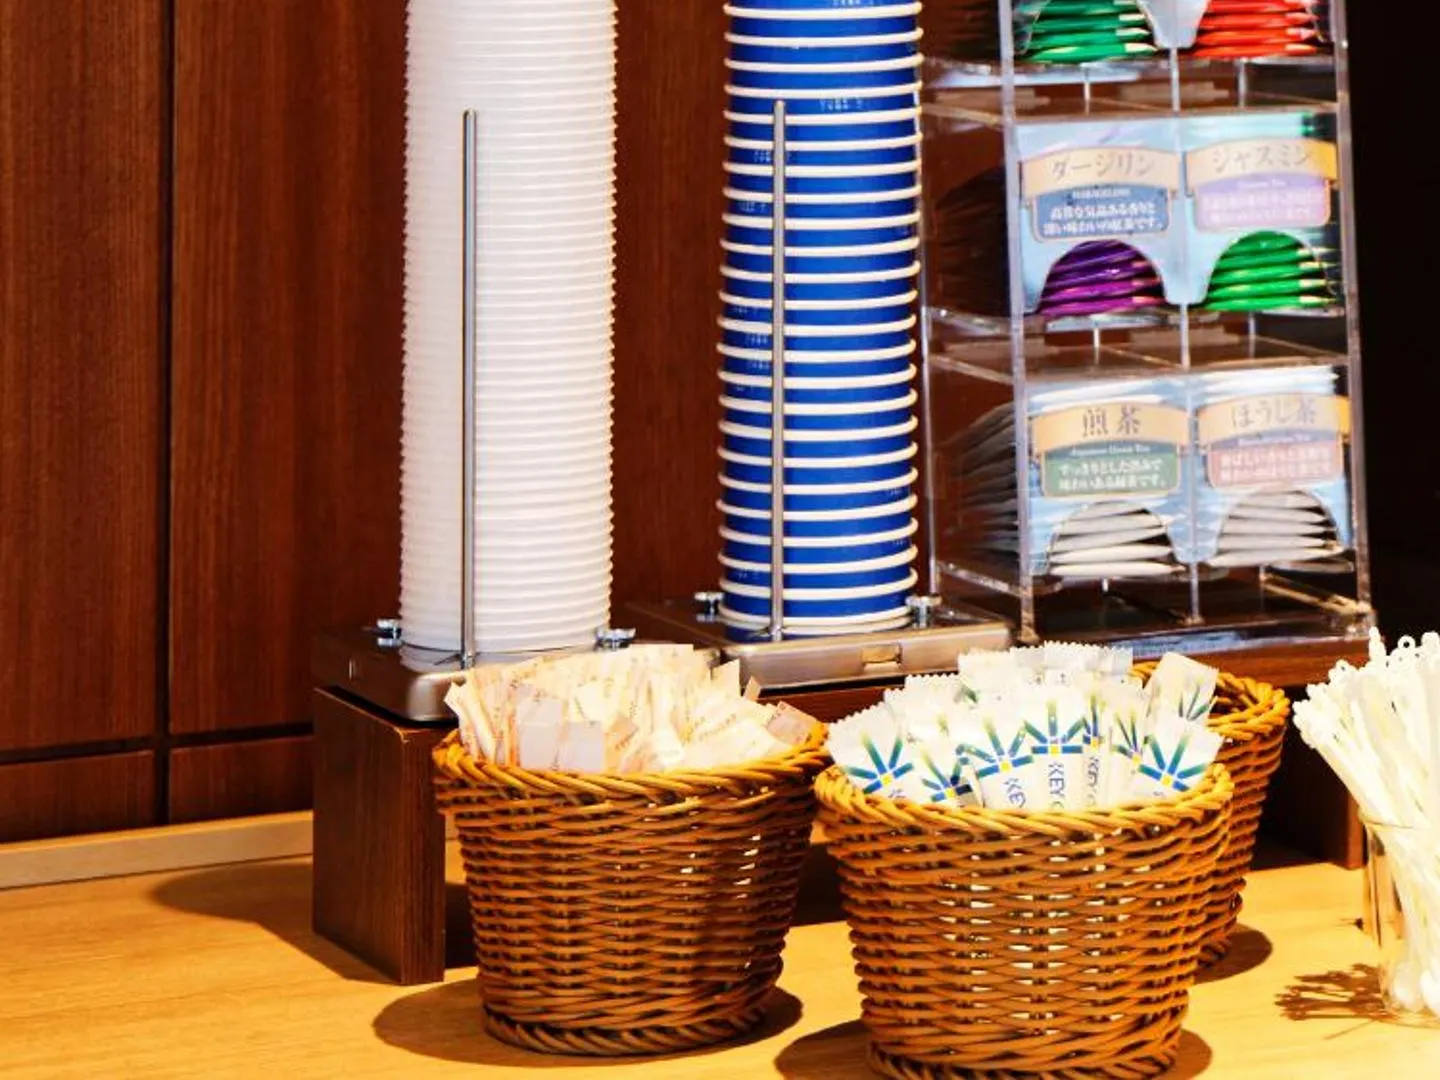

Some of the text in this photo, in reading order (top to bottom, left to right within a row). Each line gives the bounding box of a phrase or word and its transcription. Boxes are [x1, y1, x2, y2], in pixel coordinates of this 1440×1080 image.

[1053, 154, 1157, 179] ダージリン
[1213, 143, 1313, 173] ジャスミン
[1082, 405, 1142, 437] 煎茶
[1231, 398, 1318, 429] ほうじ茶
[1004, 777, 1026, 808] KE
[1047, 762, 1065, 798] KEY
